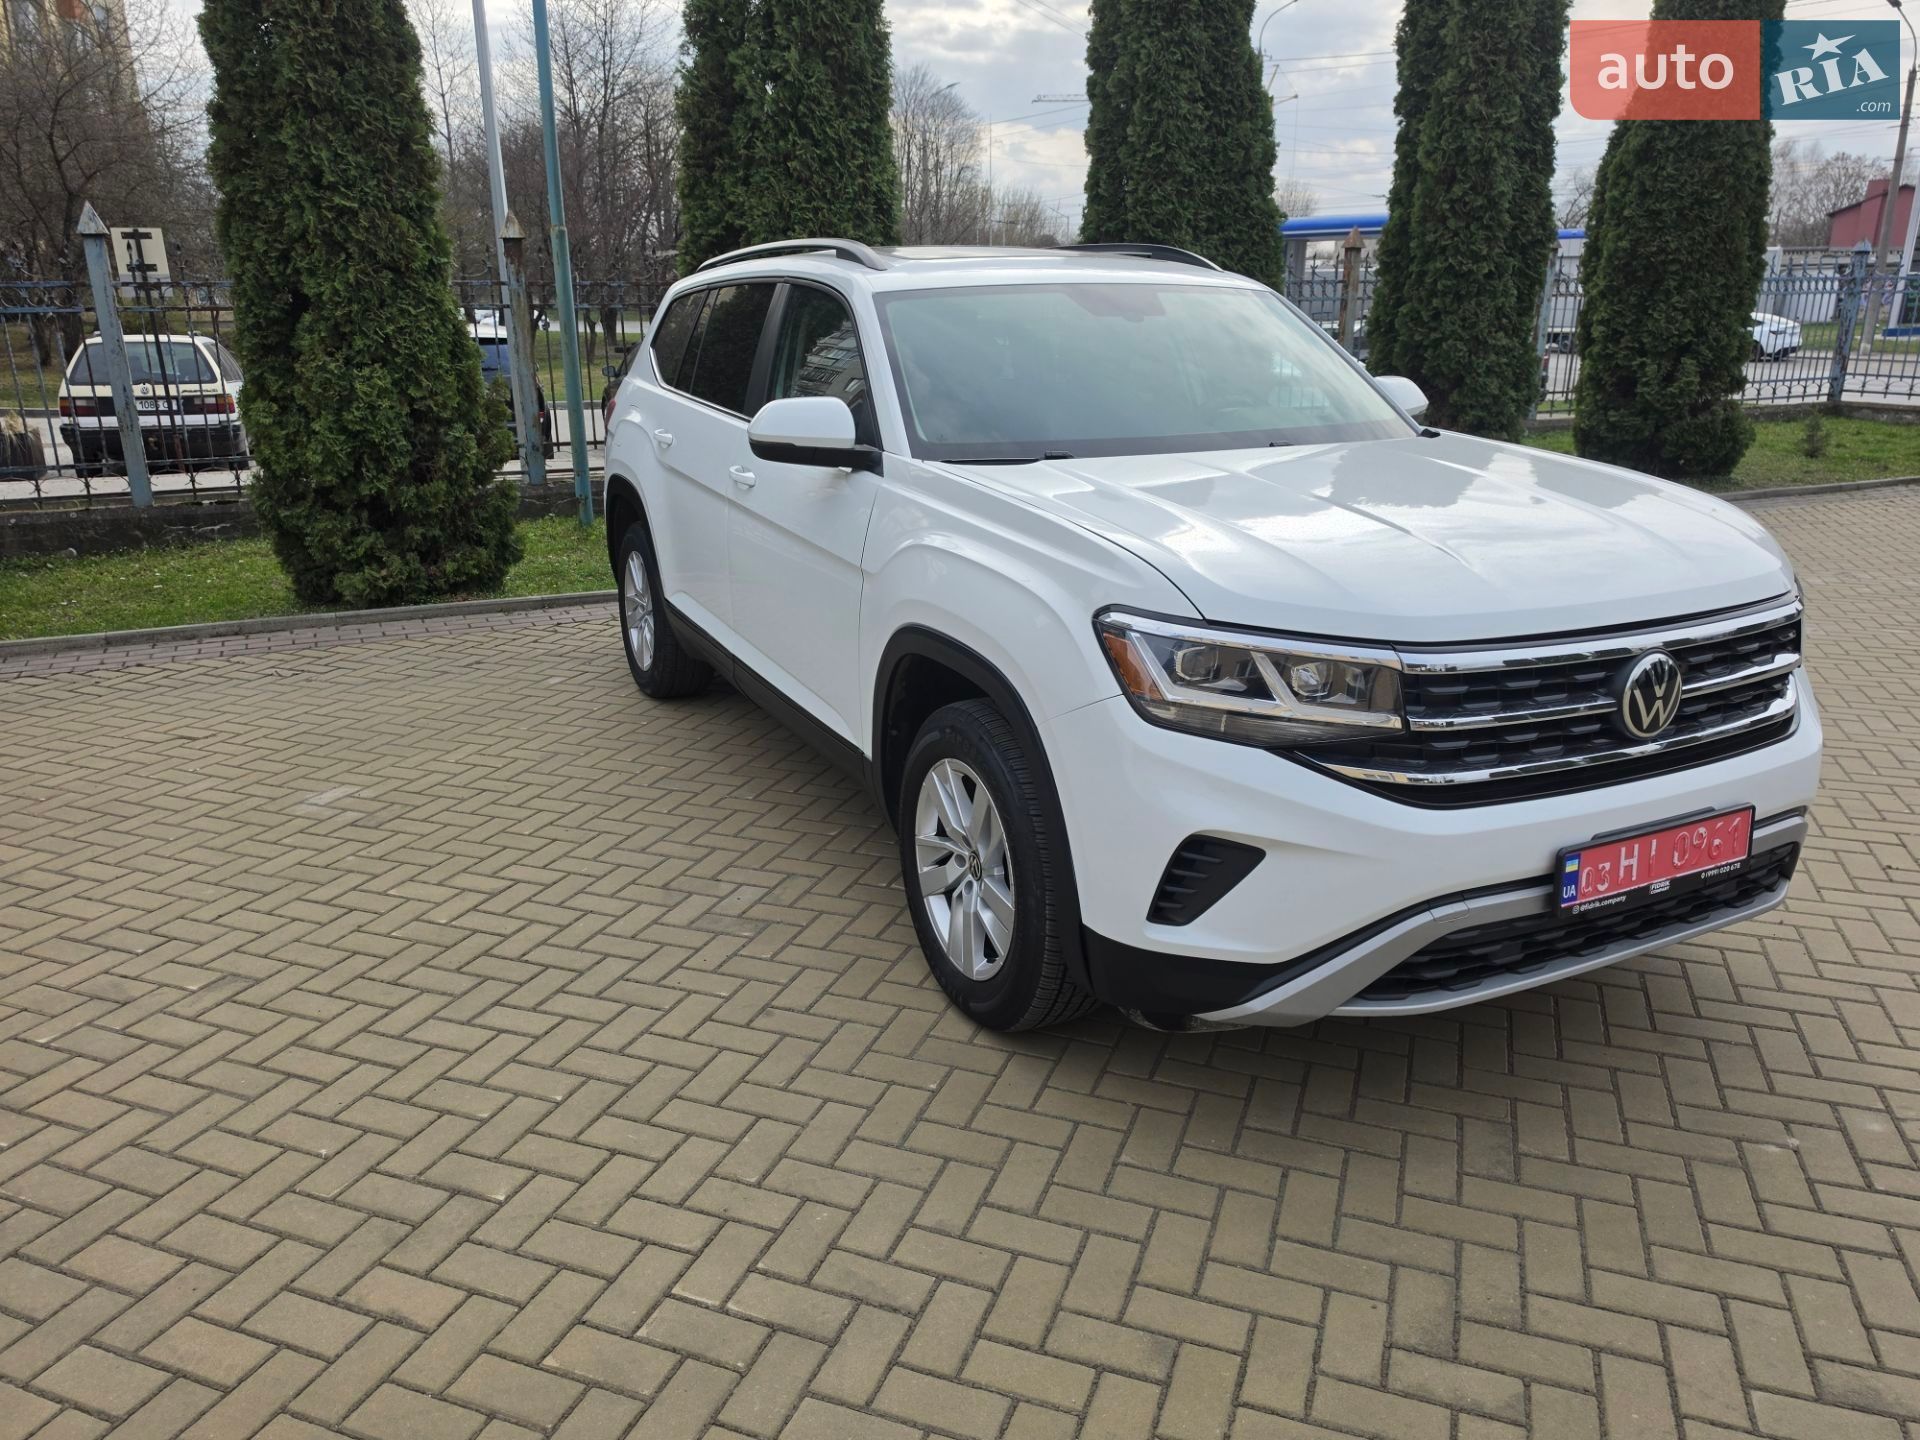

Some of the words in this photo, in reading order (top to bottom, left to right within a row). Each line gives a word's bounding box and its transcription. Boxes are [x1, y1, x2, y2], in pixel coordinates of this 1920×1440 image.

[1673, 817, 1742, 868] 0961
[1563, 883, 1576, 899] UA
[1651, 880, 1671, 890] FIDRIK
